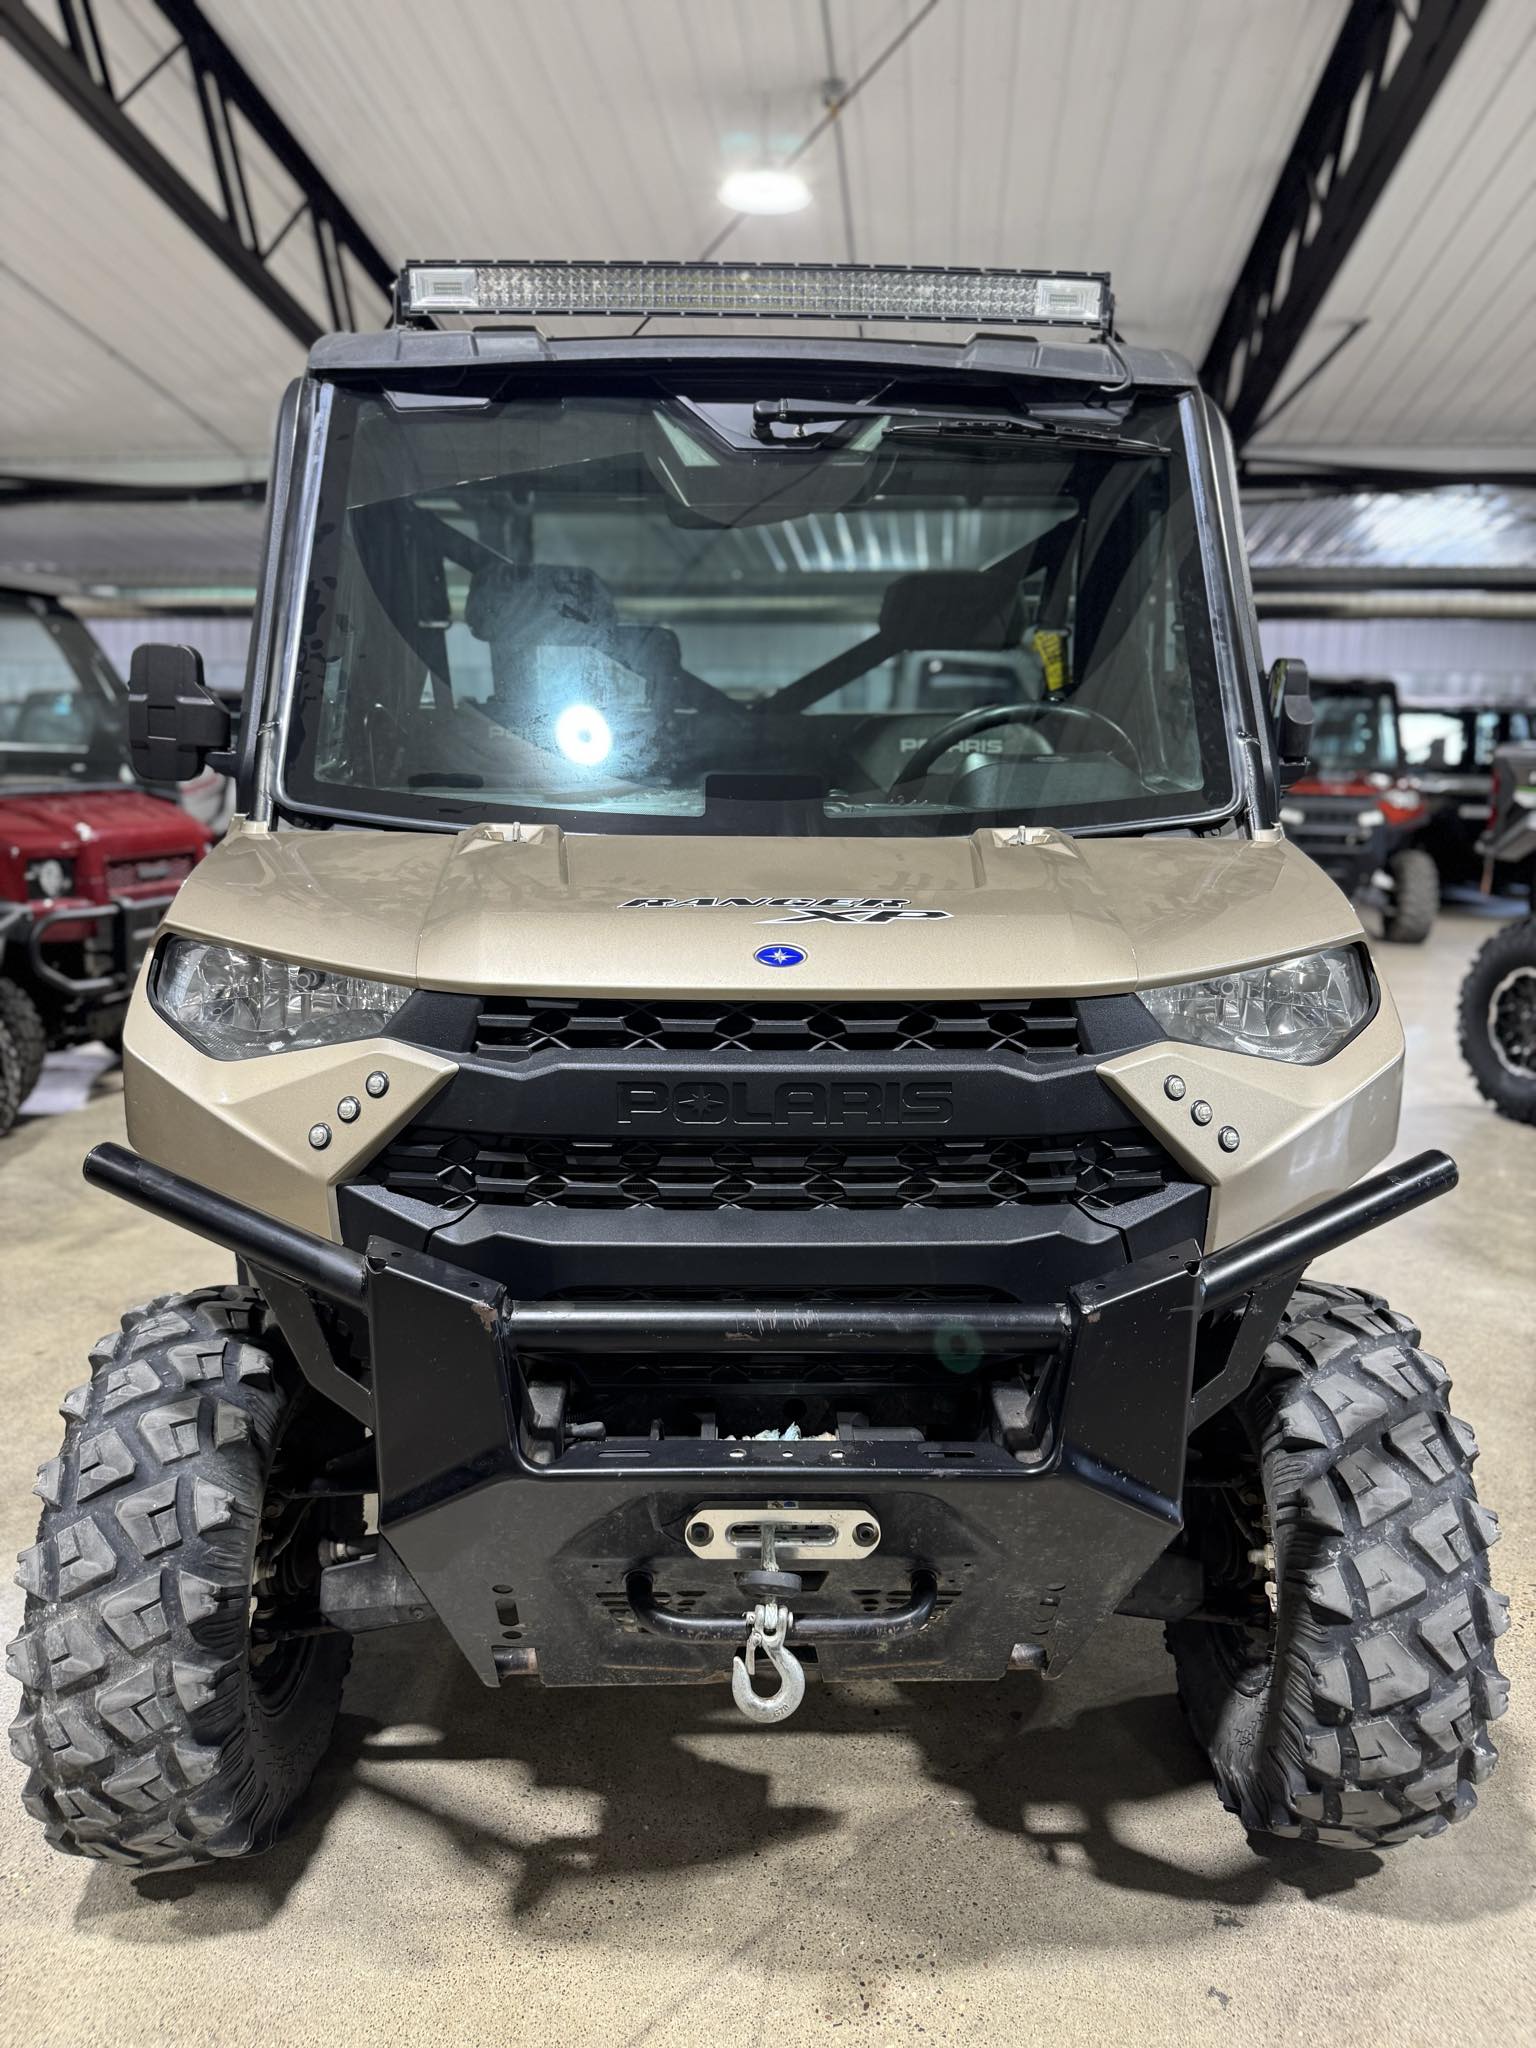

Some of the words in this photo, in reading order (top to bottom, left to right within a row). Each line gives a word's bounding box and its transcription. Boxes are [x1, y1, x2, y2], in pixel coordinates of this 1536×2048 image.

[900, 738, 1003, 753] PARIS
[617, 897, 912, 909] RANGER
[752, 908, 955, 925] XP
[616, 1081, 954, 1127] POLARIS
